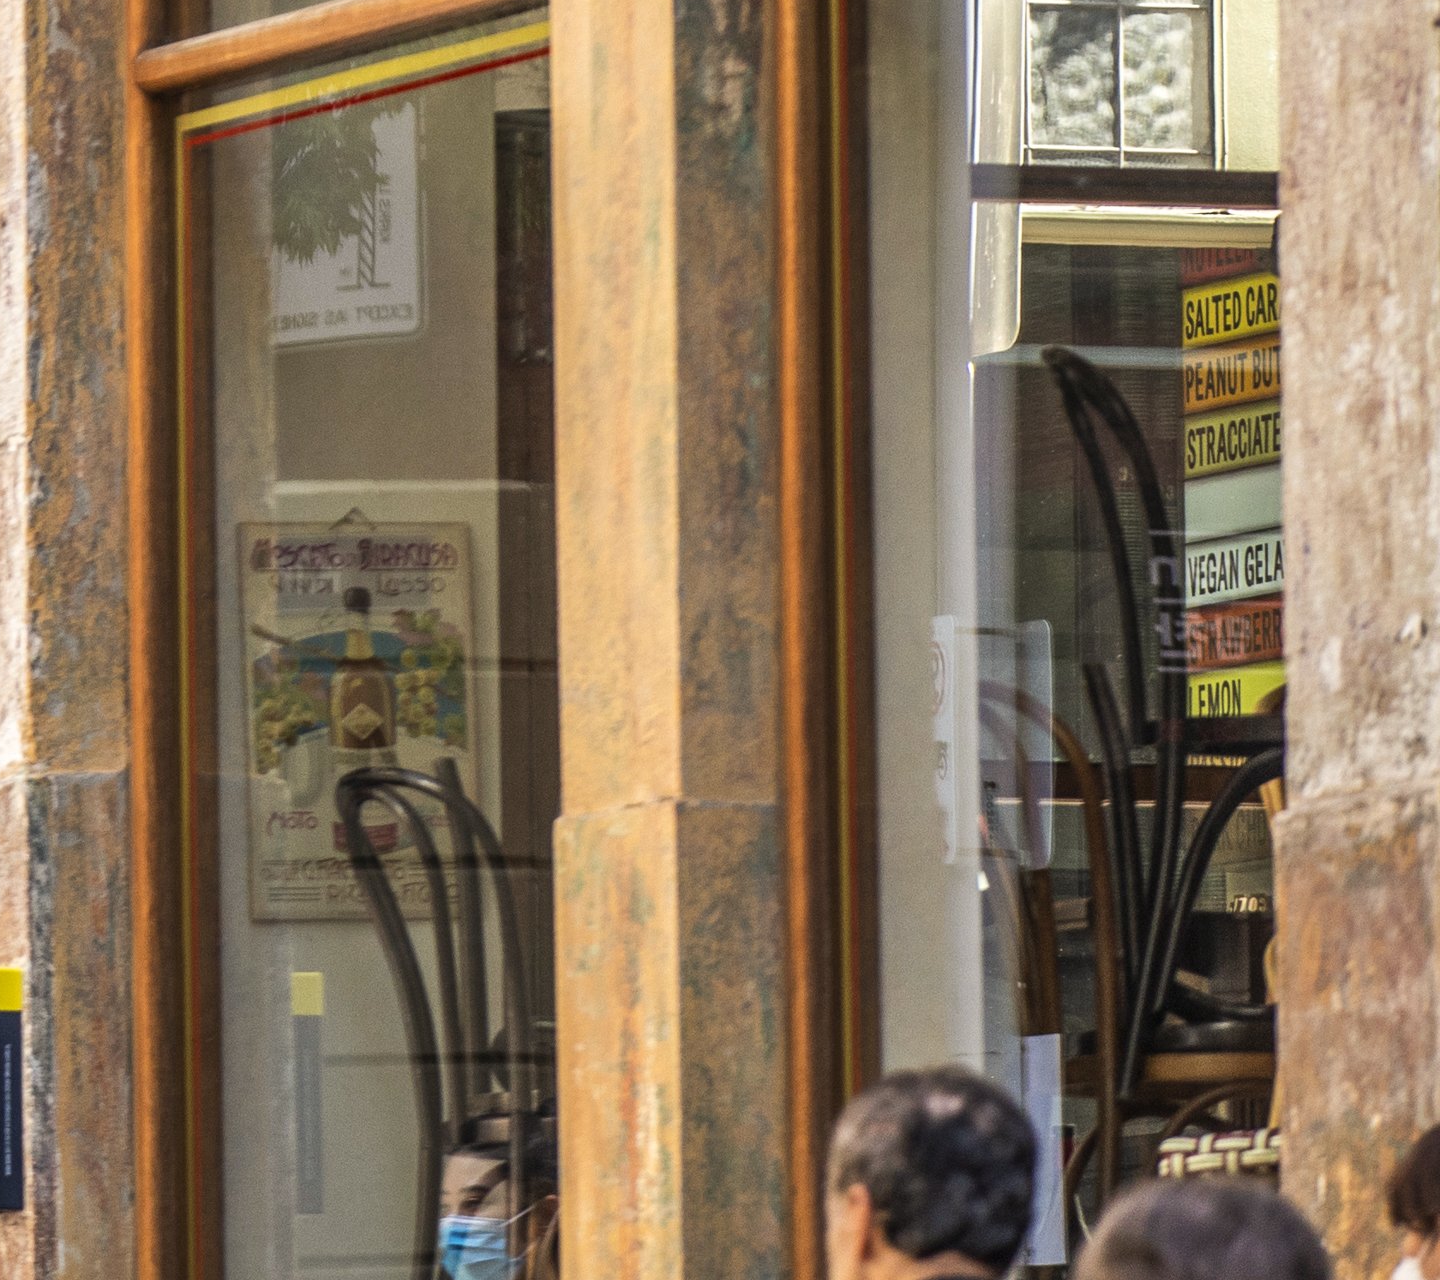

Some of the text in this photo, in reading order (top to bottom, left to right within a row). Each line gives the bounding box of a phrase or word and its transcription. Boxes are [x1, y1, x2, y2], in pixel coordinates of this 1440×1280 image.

[1186, 283, 1278, 340] SALTED CAR
[1185, 352, 1247, 403] PEANUT
[1187, 412, 1281, 469] STRACCIATE
[1188, 549, 1239, 596] VEGAN
[1188, 679, 1241, 718] LEMON
